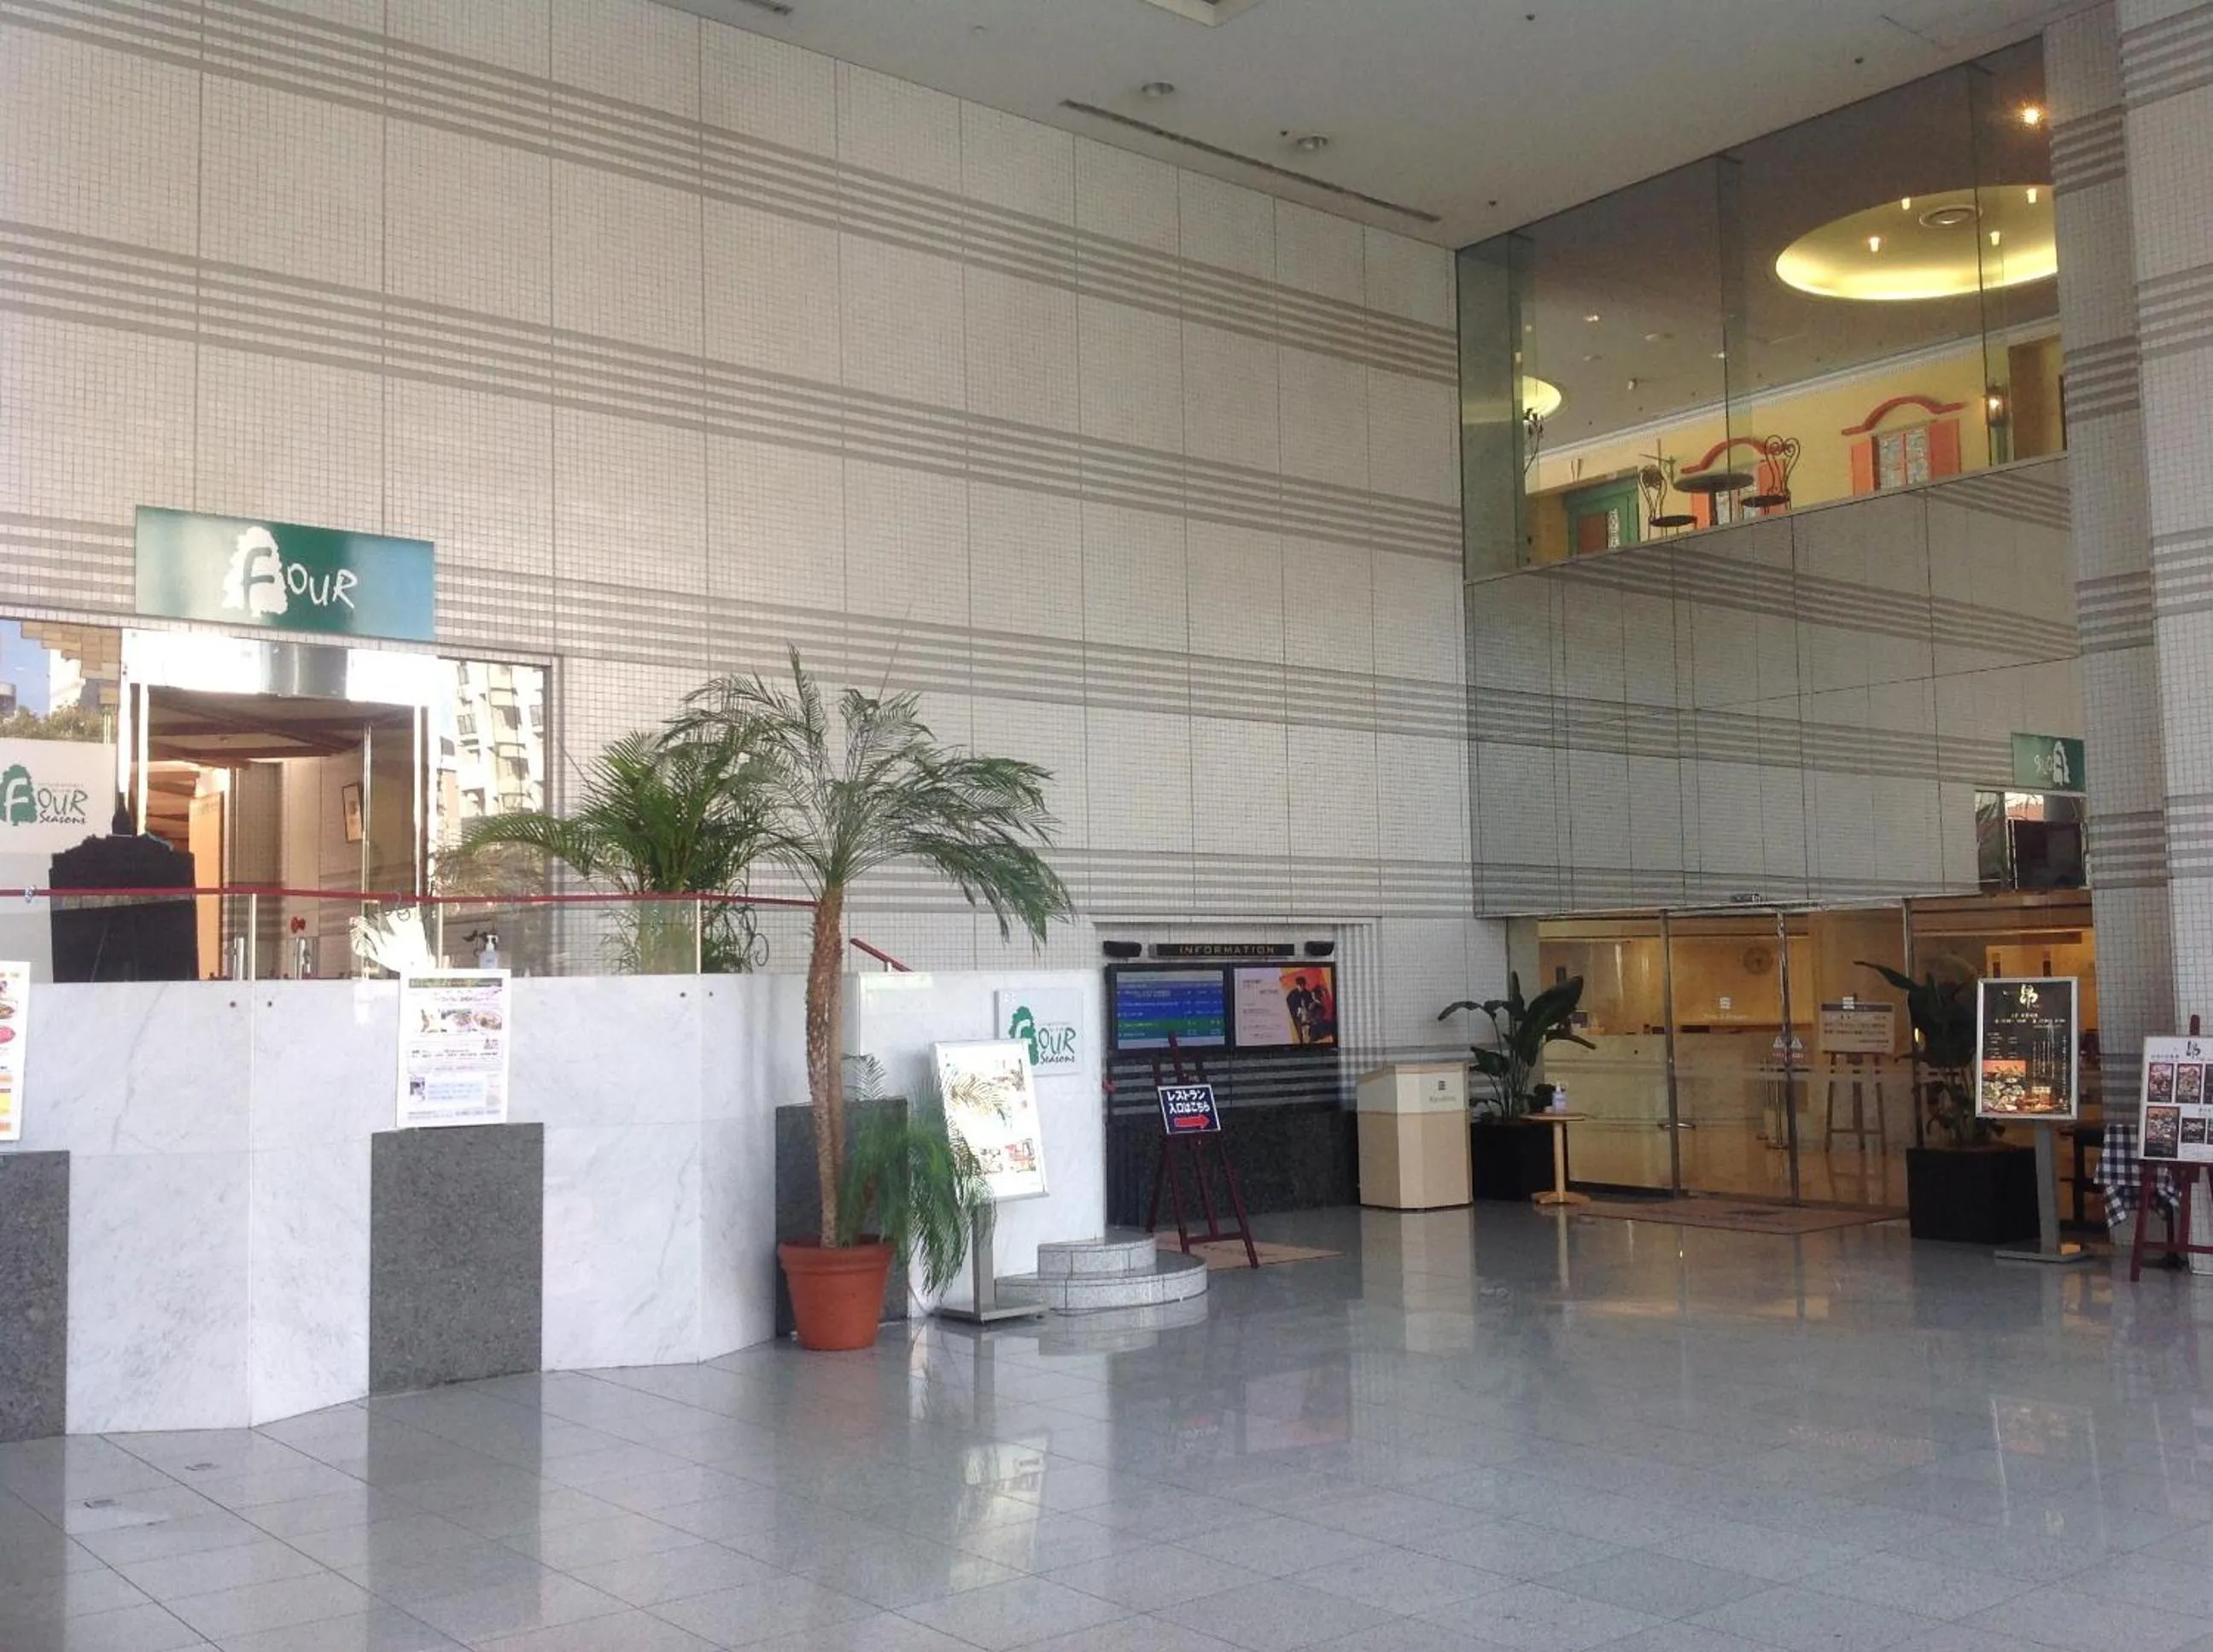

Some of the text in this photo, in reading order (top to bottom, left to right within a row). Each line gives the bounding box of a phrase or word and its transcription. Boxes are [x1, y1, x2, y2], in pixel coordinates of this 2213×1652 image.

[237, 544, 359, 616] FOUR
[3, 776, 89, 825] FOUR
[38, 810, 86, 824] Seasons
[1179, 945, 1276, 955] INFORMATION
[1040, 1051, 1076, 1064] Seasons
[1166, 1089, 1206, 1101] レストラン
[1169, 1101, 1211, 1114] 入口はこちら
